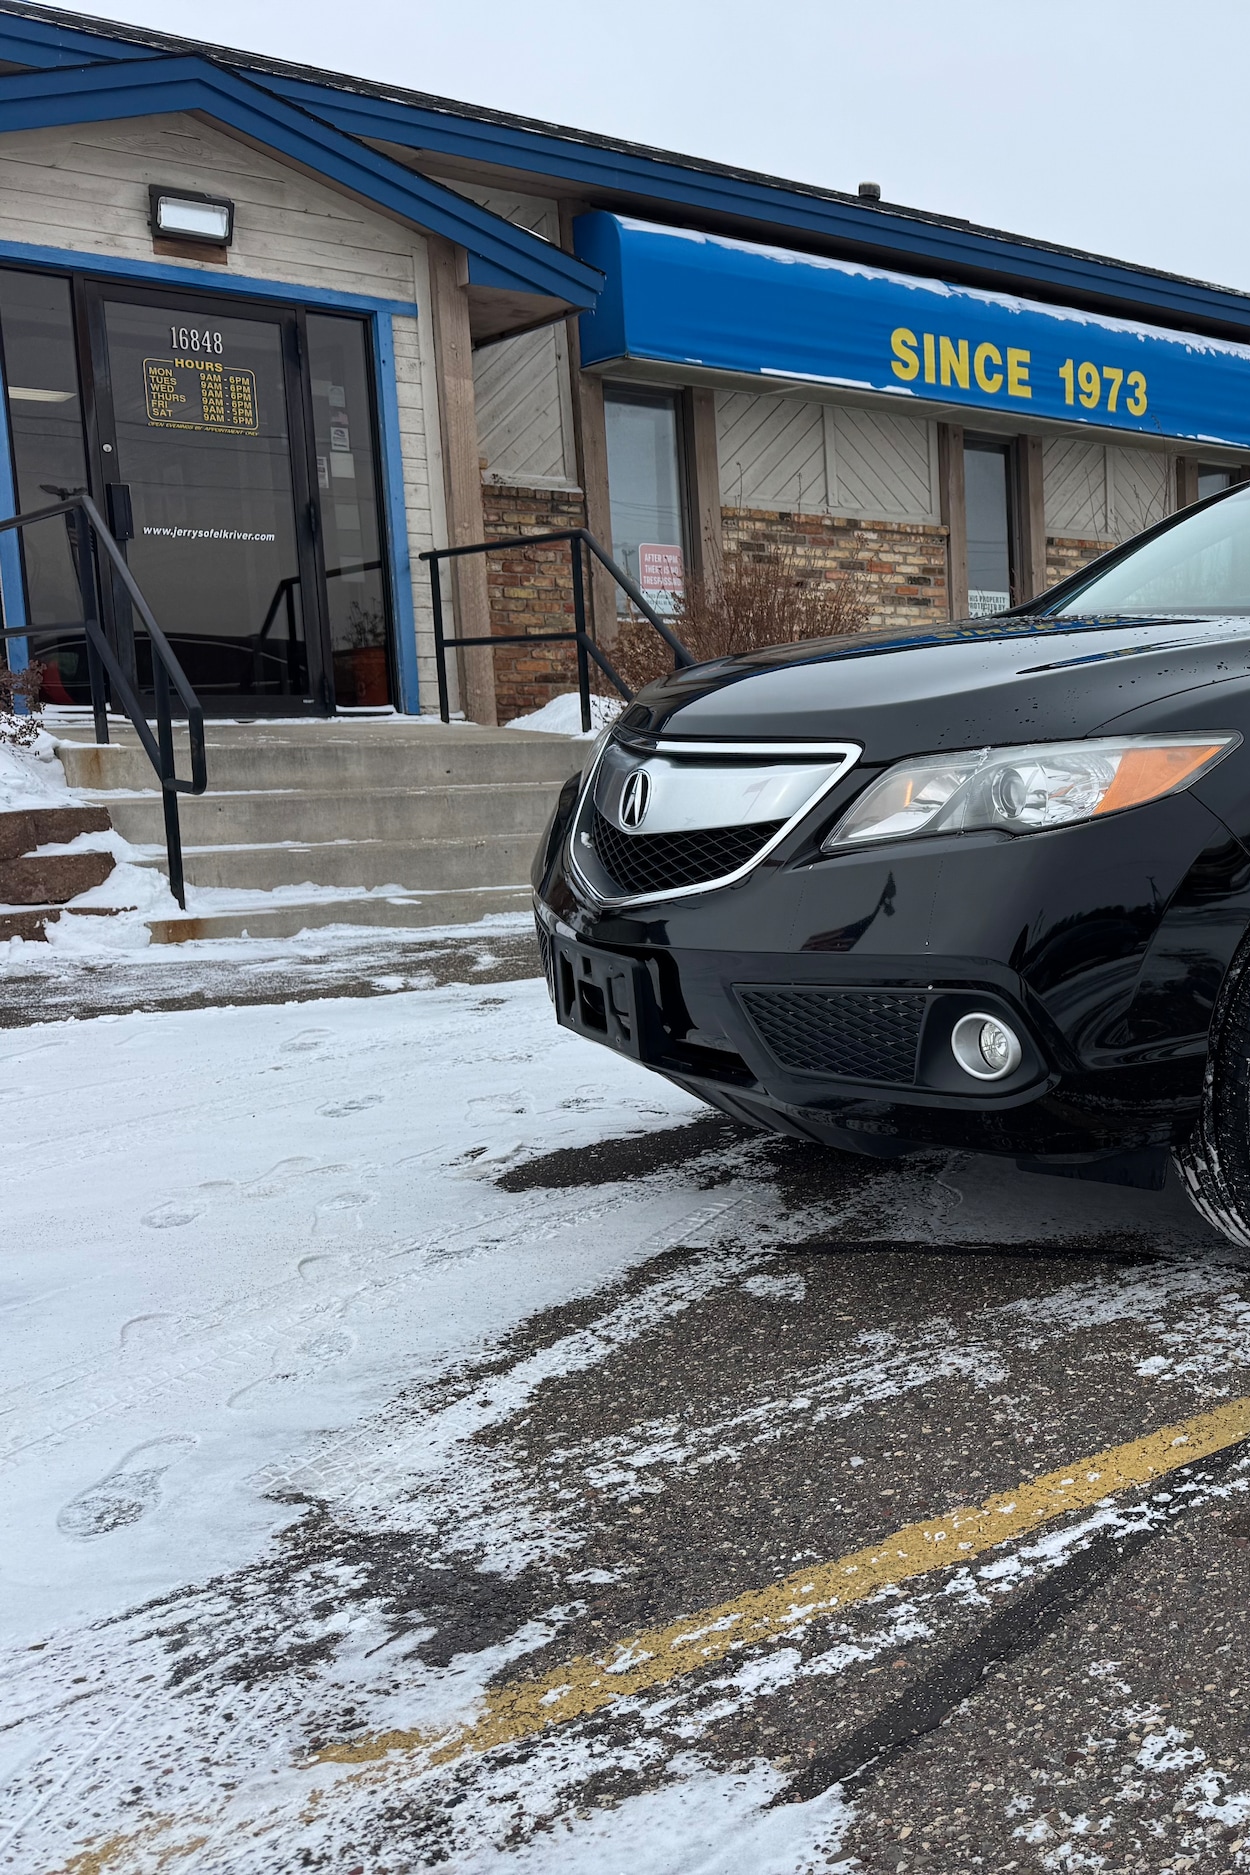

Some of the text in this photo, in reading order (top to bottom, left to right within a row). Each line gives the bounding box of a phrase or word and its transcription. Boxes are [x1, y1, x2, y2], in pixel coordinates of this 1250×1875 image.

[170, 326, 223, 354] 16848
[174, 358, 223, 372] HOURS
[890, 327, 1148, 416] SINCE 1973
[149, 367, 172, 376] MON
[200, 373, 221, 382] 9AM
[230, 376, 250, 385] 6PM
[150, 376, 177, 386] TUES
[201, 382, 222, 390] 9AM
[230, 385, 250, 393] 6PM
[150, 384, 174, 393] WED
[201, 390, 223, 398] 9AM
[231, 392, 251, 401] 6PM
[151, 392, 186, 402] THURS
[202, 398, 223, 406] 9AM
[232, 400, 252, 409] 6PM
[152, 400, 168, 408] FRI
[203, 406, 224, 414] 9AM
[232, 409, 252, 417] 5PM
[152, 409, 173, 417] SAT
[204, 414, 224, 422] 9AM
[233, 416, 253, 425] 5PM
[204, 427, 244, 435] APPOINTMENT
[143, 526, 275, 541] www.jerrysofelkriver.com
[644, 554, 661, 563] AFTER
[645, 565, 662, 574] THERE
[664, 566, 670, 574] IS
[644, 576, 681, 586] TRESPSSNG
